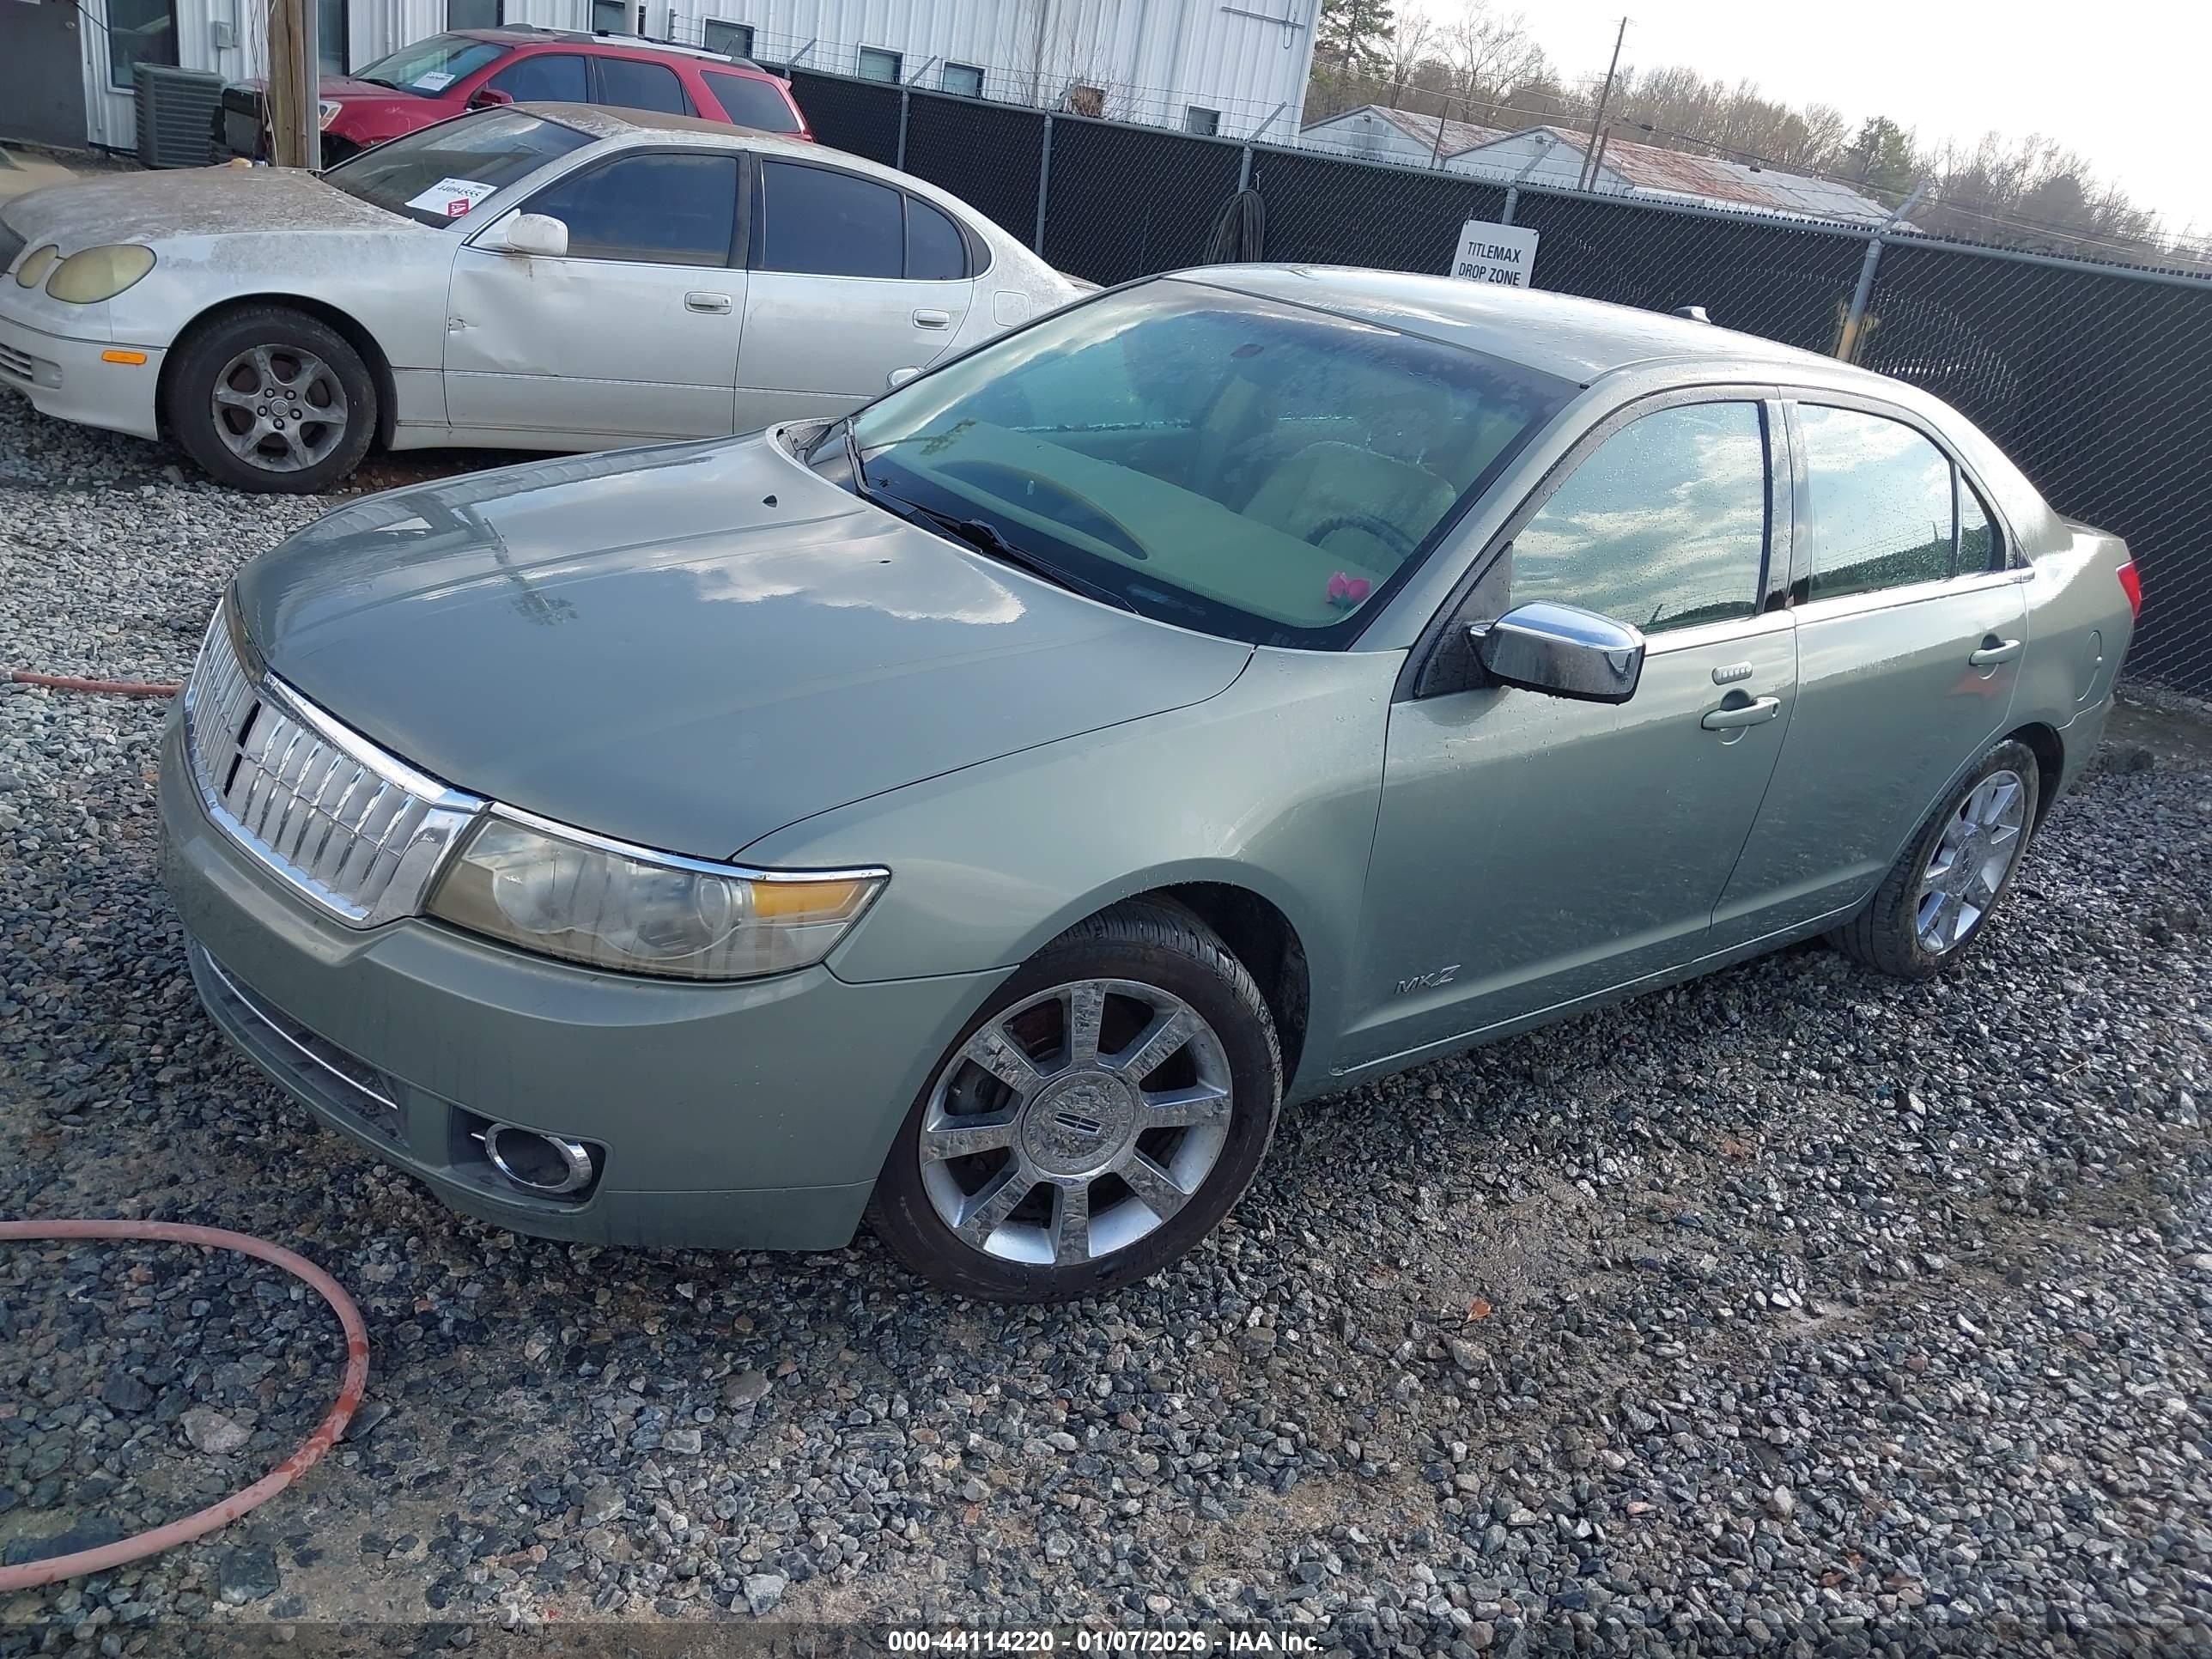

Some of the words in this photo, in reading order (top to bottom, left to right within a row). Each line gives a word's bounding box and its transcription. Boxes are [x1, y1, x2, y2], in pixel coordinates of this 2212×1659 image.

[1468, 241, 1522, 264] TITLEMAX
[1458, 262, 1486, 280] DROP
[1488, 267, 1522, 286] ZONE
[1394, 964, 1462, 996] MKZ
